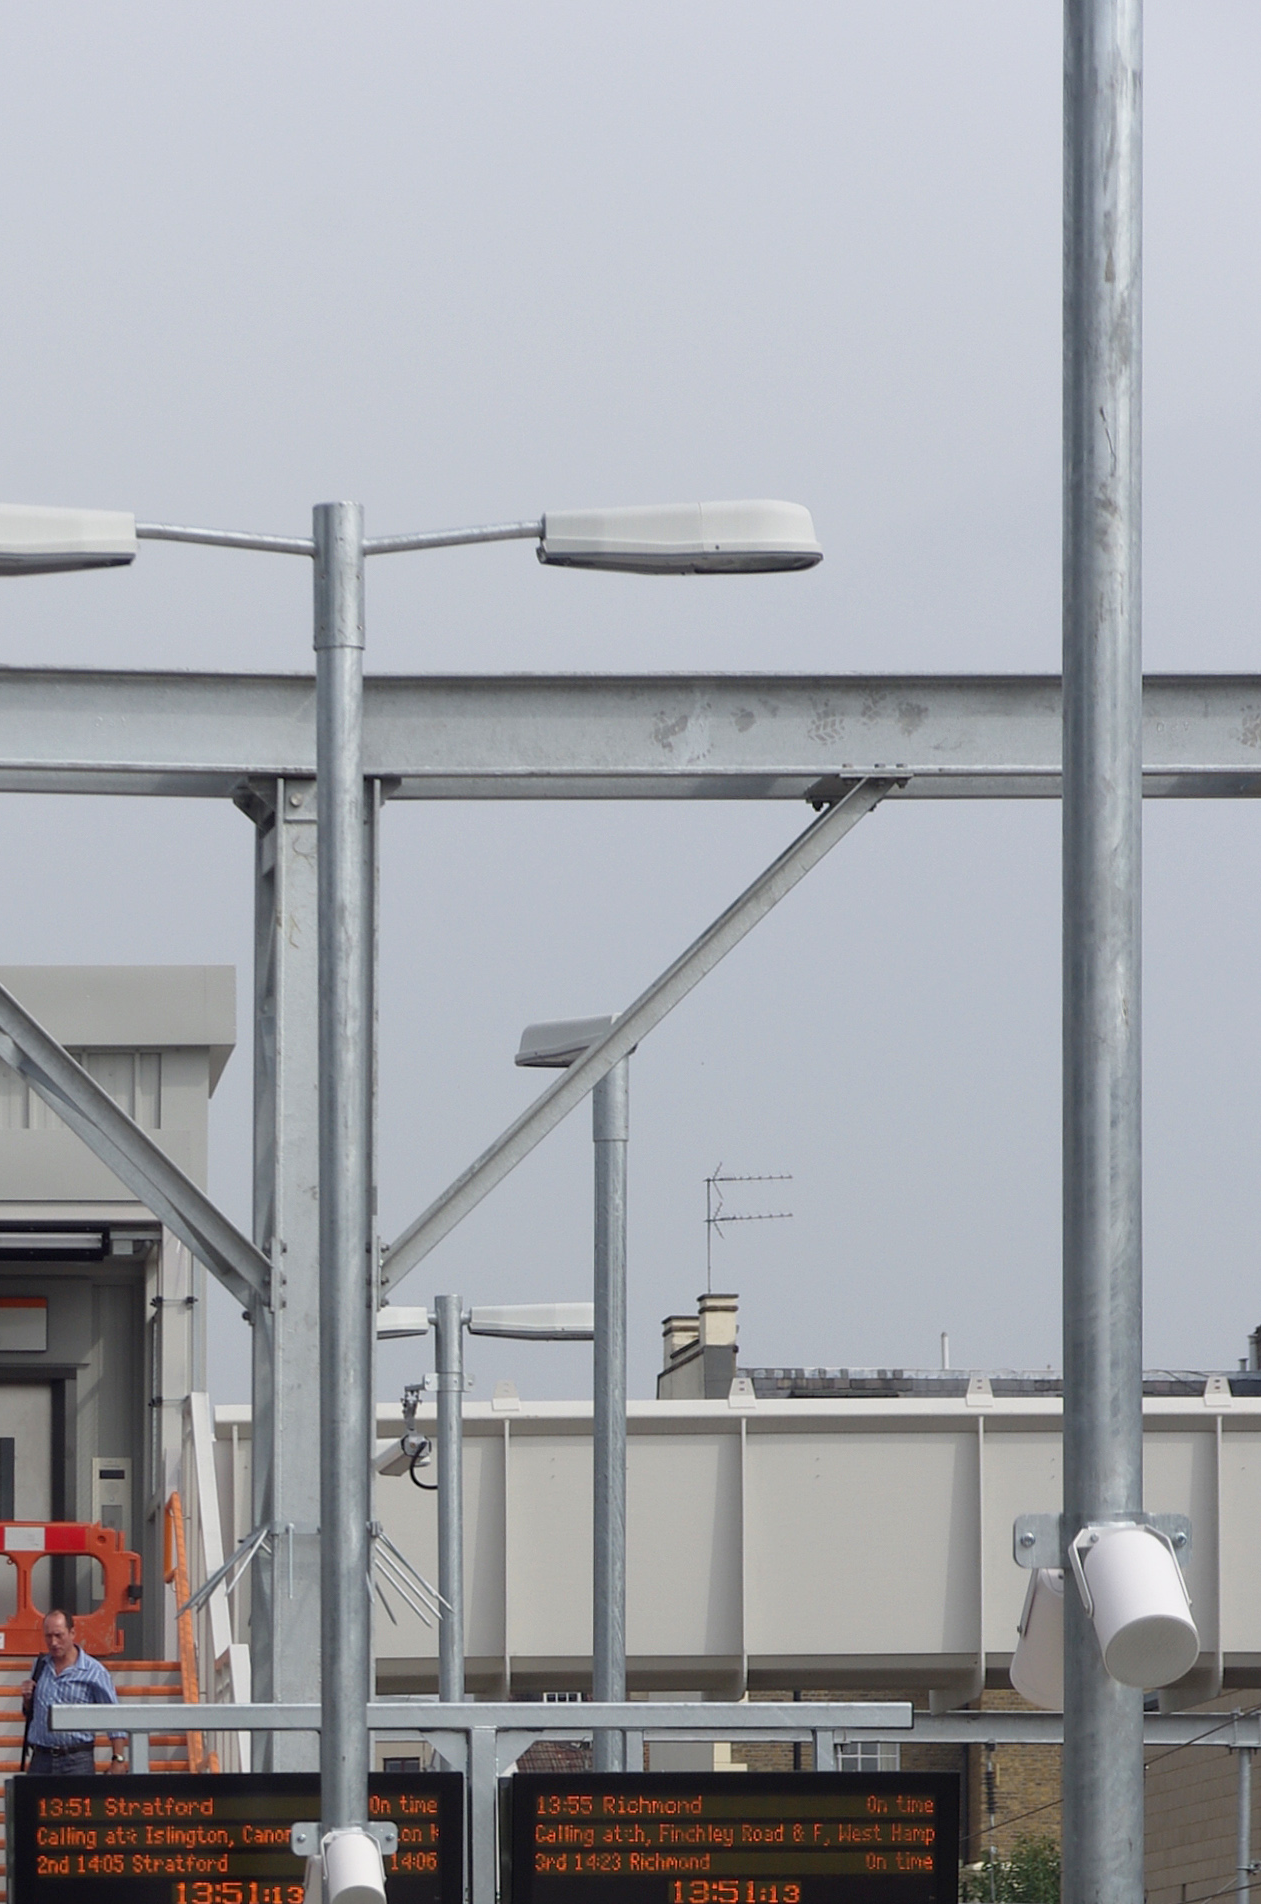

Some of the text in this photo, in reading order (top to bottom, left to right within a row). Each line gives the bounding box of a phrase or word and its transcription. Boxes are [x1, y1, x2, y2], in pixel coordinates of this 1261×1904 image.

[39, 1795, 438, 1817] 13:51 Stratford On time
[537, 1795, 934, 1815] 13:55 Richmond On time
[37, 1827, 98, 1849] Calling
[145, 1826, 235, 1848] Islington,
[535, 1825, 595, 1848] Calling
[659, 1824, 734, 1848] Finchley
[741, 1824, 785, 1843] Road
[792, 1823, 805, 1843] &
[813, 1823, 830, 1847] F,
[838, 1824, 882, 1842] West
[892, 1824, 936, 1846] Hamp
[37, 1852, 438, 1875] 2nd 14:05 Stratford 14:06
[534, 1852, 934, 1872] 3rd 14:23 Richmond On time
[673, 1880, 801, 1904] 13:51:13
